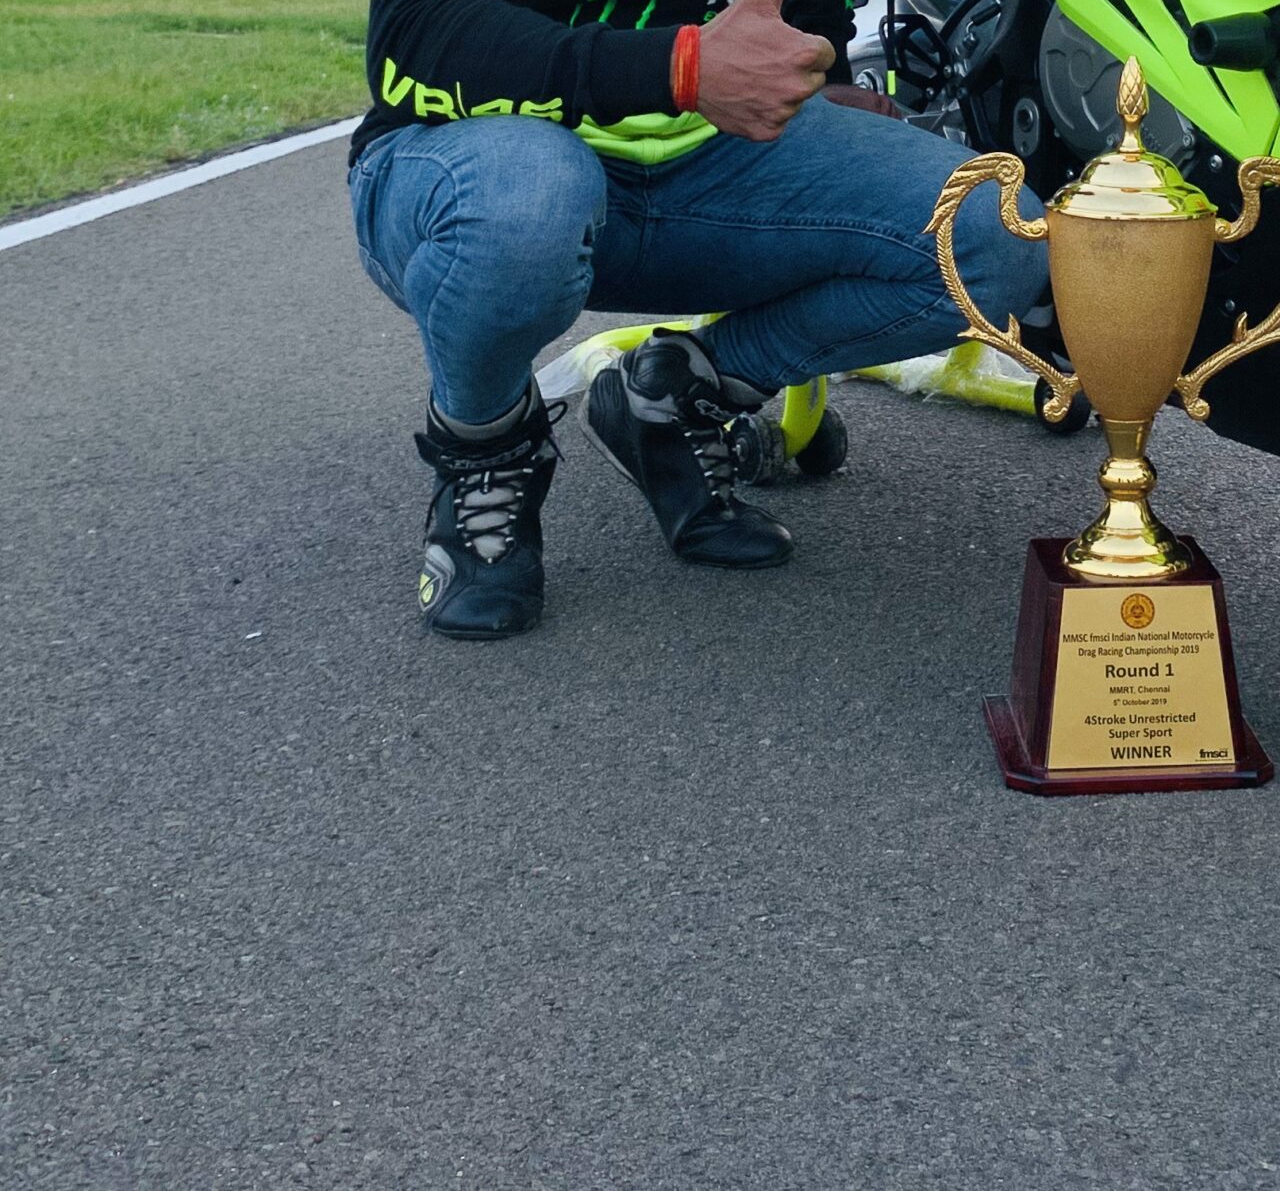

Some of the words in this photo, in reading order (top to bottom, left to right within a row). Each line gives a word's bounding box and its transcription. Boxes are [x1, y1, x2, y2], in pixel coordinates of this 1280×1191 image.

[1062, 634, 1088, 643] MMSC
[1089, 632, 1111, 643] fmsci
[1111, 632, 1136, 642] Indian
[1137, 631, 1170, 641] National
[1171, 630, 1215, 642] Motorcycle
[1078, 647, 1097, 658] Drag
[1098, 647, 1123, 657] Racing
[1124, 645, 1180, 657] Championship
[1180, 644, 1200, 654] 2019
[1105, 663, 1160, 678] Round
[1165, 663, 1175, 676] 1
[1138, 685, 1171, 693] Chennai
[1122, 698, 1150, 706] October
[1084, 715, 1126, 726] 4Stroke
[1128, 712, 1196, 724] Unrestricted
[1108, 728, 1140, 740] Super
[1143, 727, 1173, 739] Sport
[1110, 745, 1172, 759] WINNER
[1199, 748, 1228, 758] fmsci
